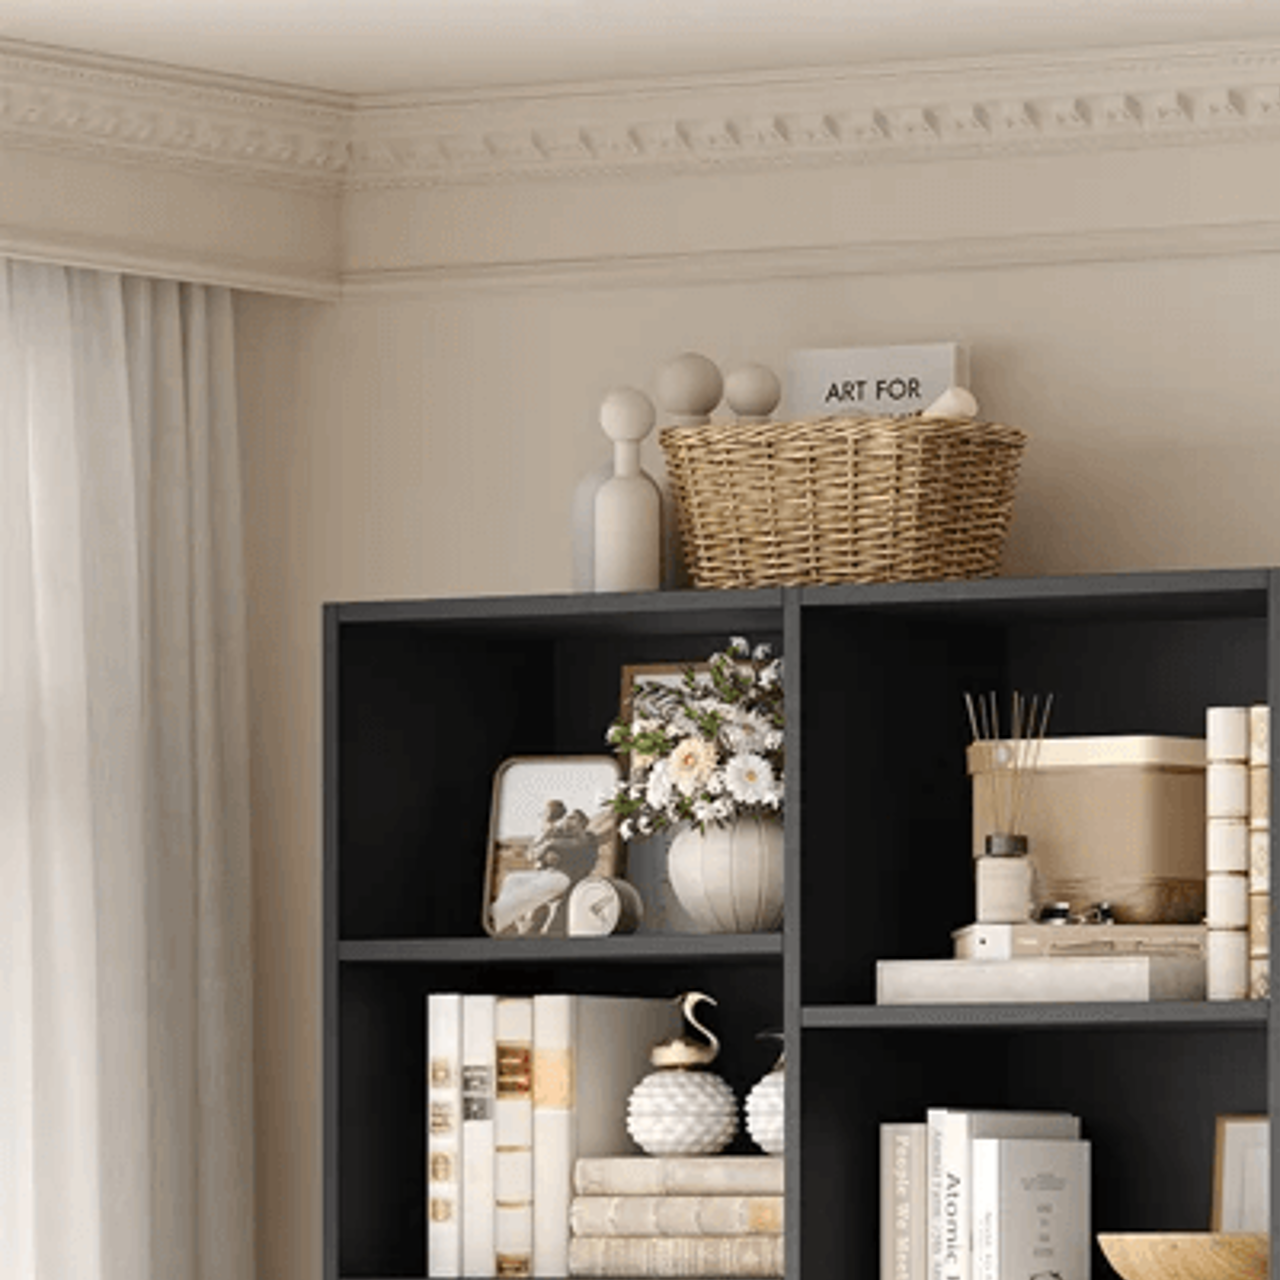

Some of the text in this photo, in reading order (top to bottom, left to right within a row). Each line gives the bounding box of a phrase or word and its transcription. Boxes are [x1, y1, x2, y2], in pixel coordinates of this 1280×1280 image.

[825, 377, 921, 403] ART FOR
[892, 1135, 911, 1196] People
[895, 1202, 911, 1230] We
[946, 1172, 962, 1265] Atomic
[895, 1236, 911, 1280] Meet
